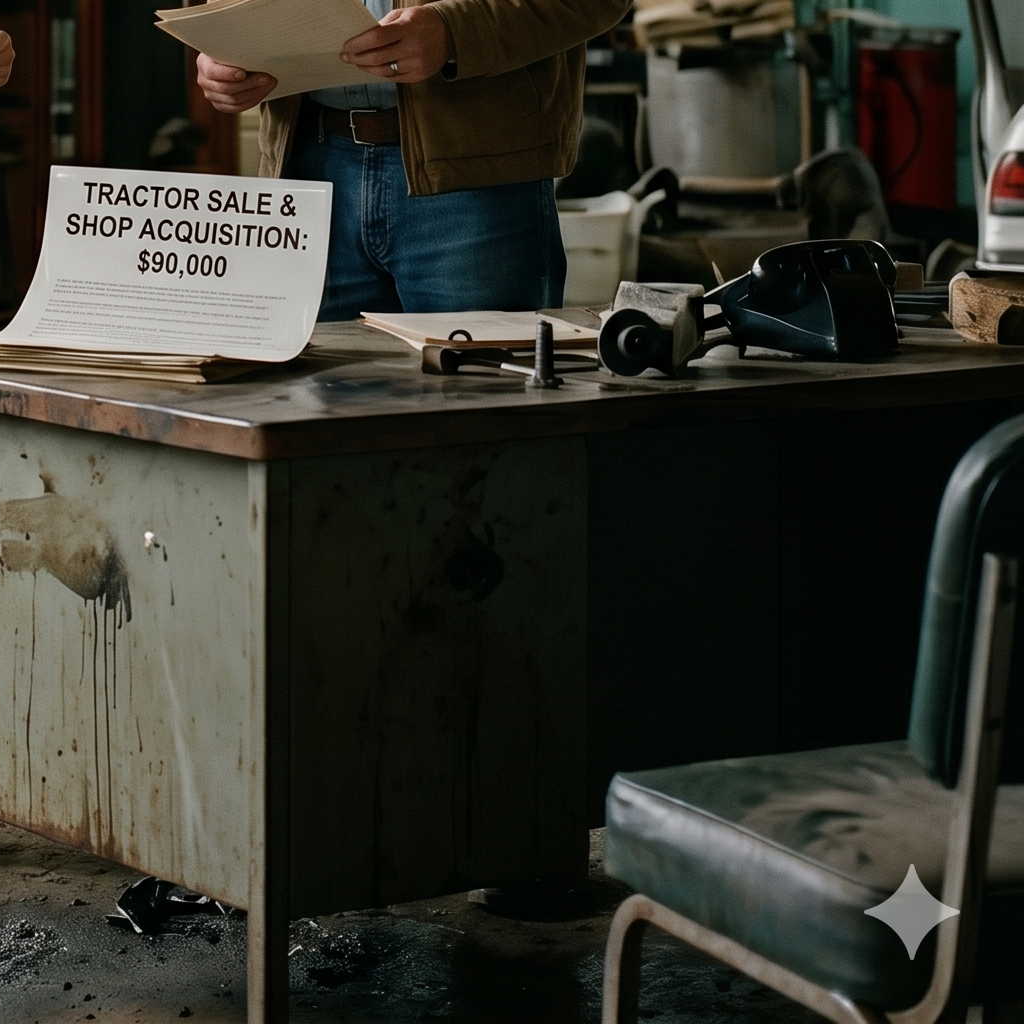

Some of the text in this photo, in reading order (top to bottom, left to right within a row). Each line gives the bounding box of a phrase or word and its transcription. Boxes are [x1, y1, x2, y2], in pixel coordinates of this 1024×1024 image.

[83, 182, 297, 217] TRACTOR SALE &
[65, 213, 308, 250] SHOP ACQUISITION:
[137, 249, 228, 279] $90,000
